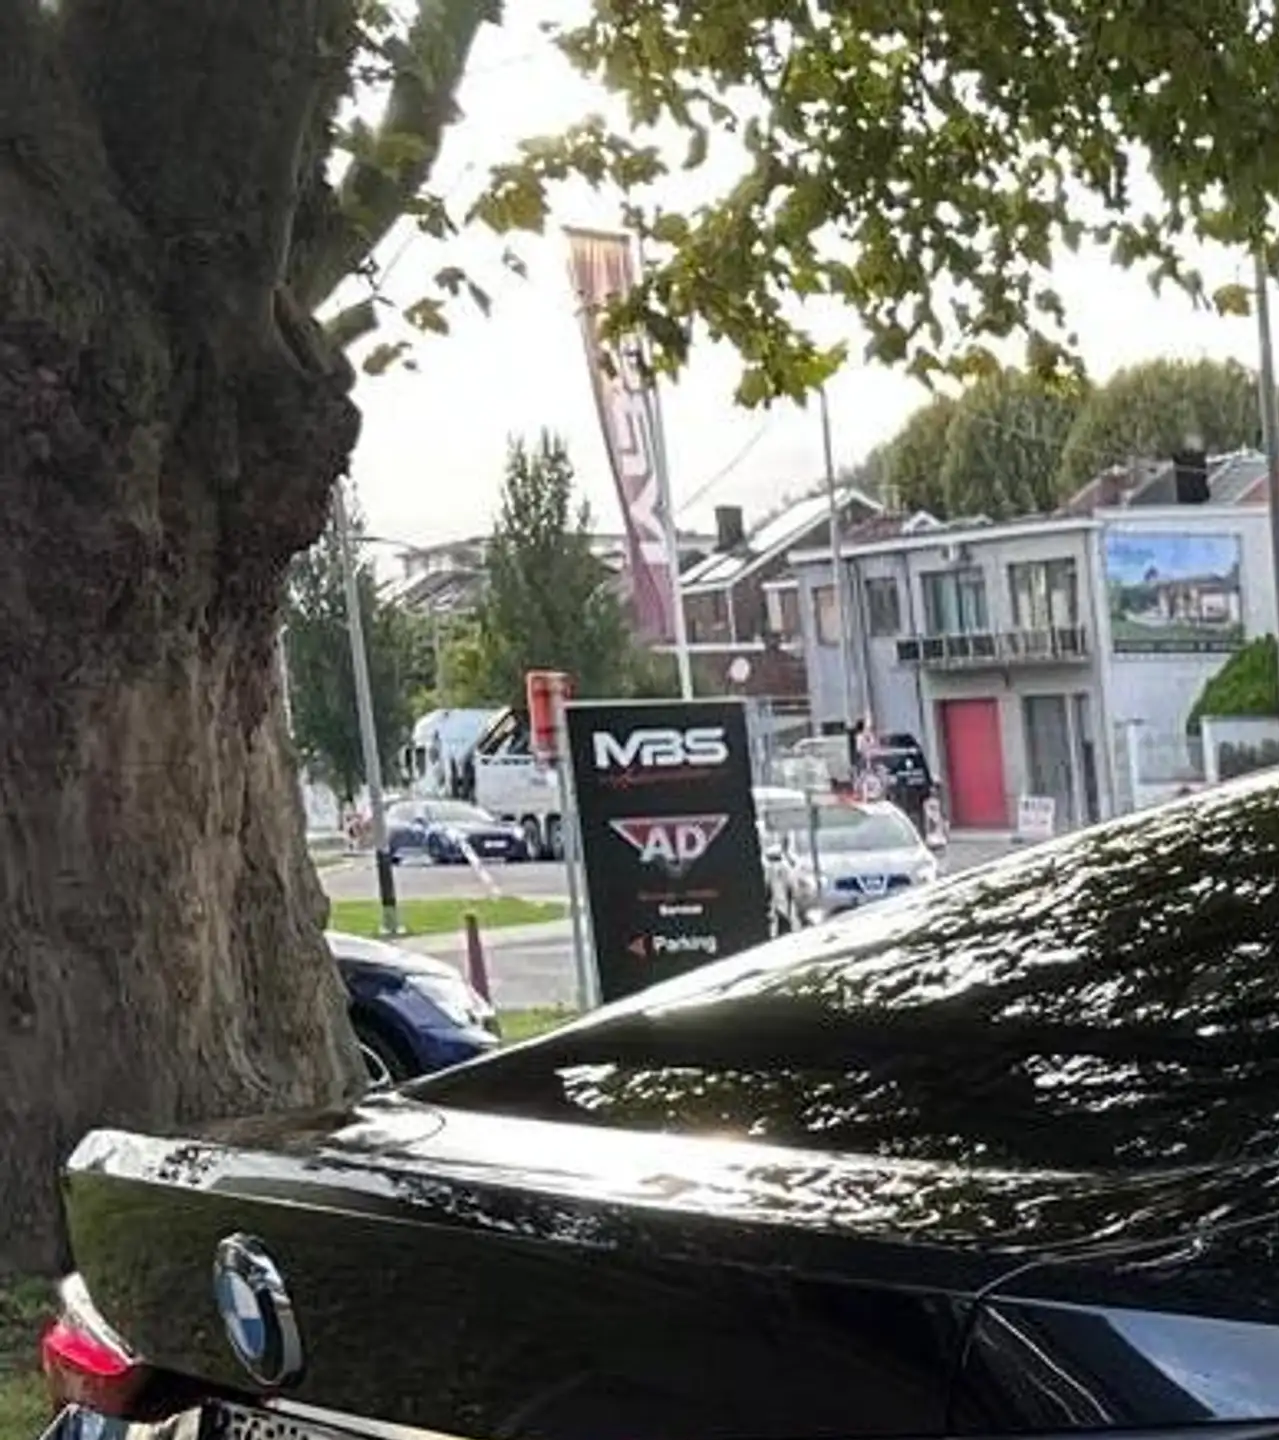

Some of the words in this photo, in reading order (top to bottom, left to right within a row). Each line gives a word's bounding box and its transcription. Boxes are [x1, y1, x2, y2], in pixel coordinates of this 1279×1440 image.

[592, 727, 729, 769] MBS
[639, 824, 707, 862] AD
[652, 935, 717, 956] Parking
